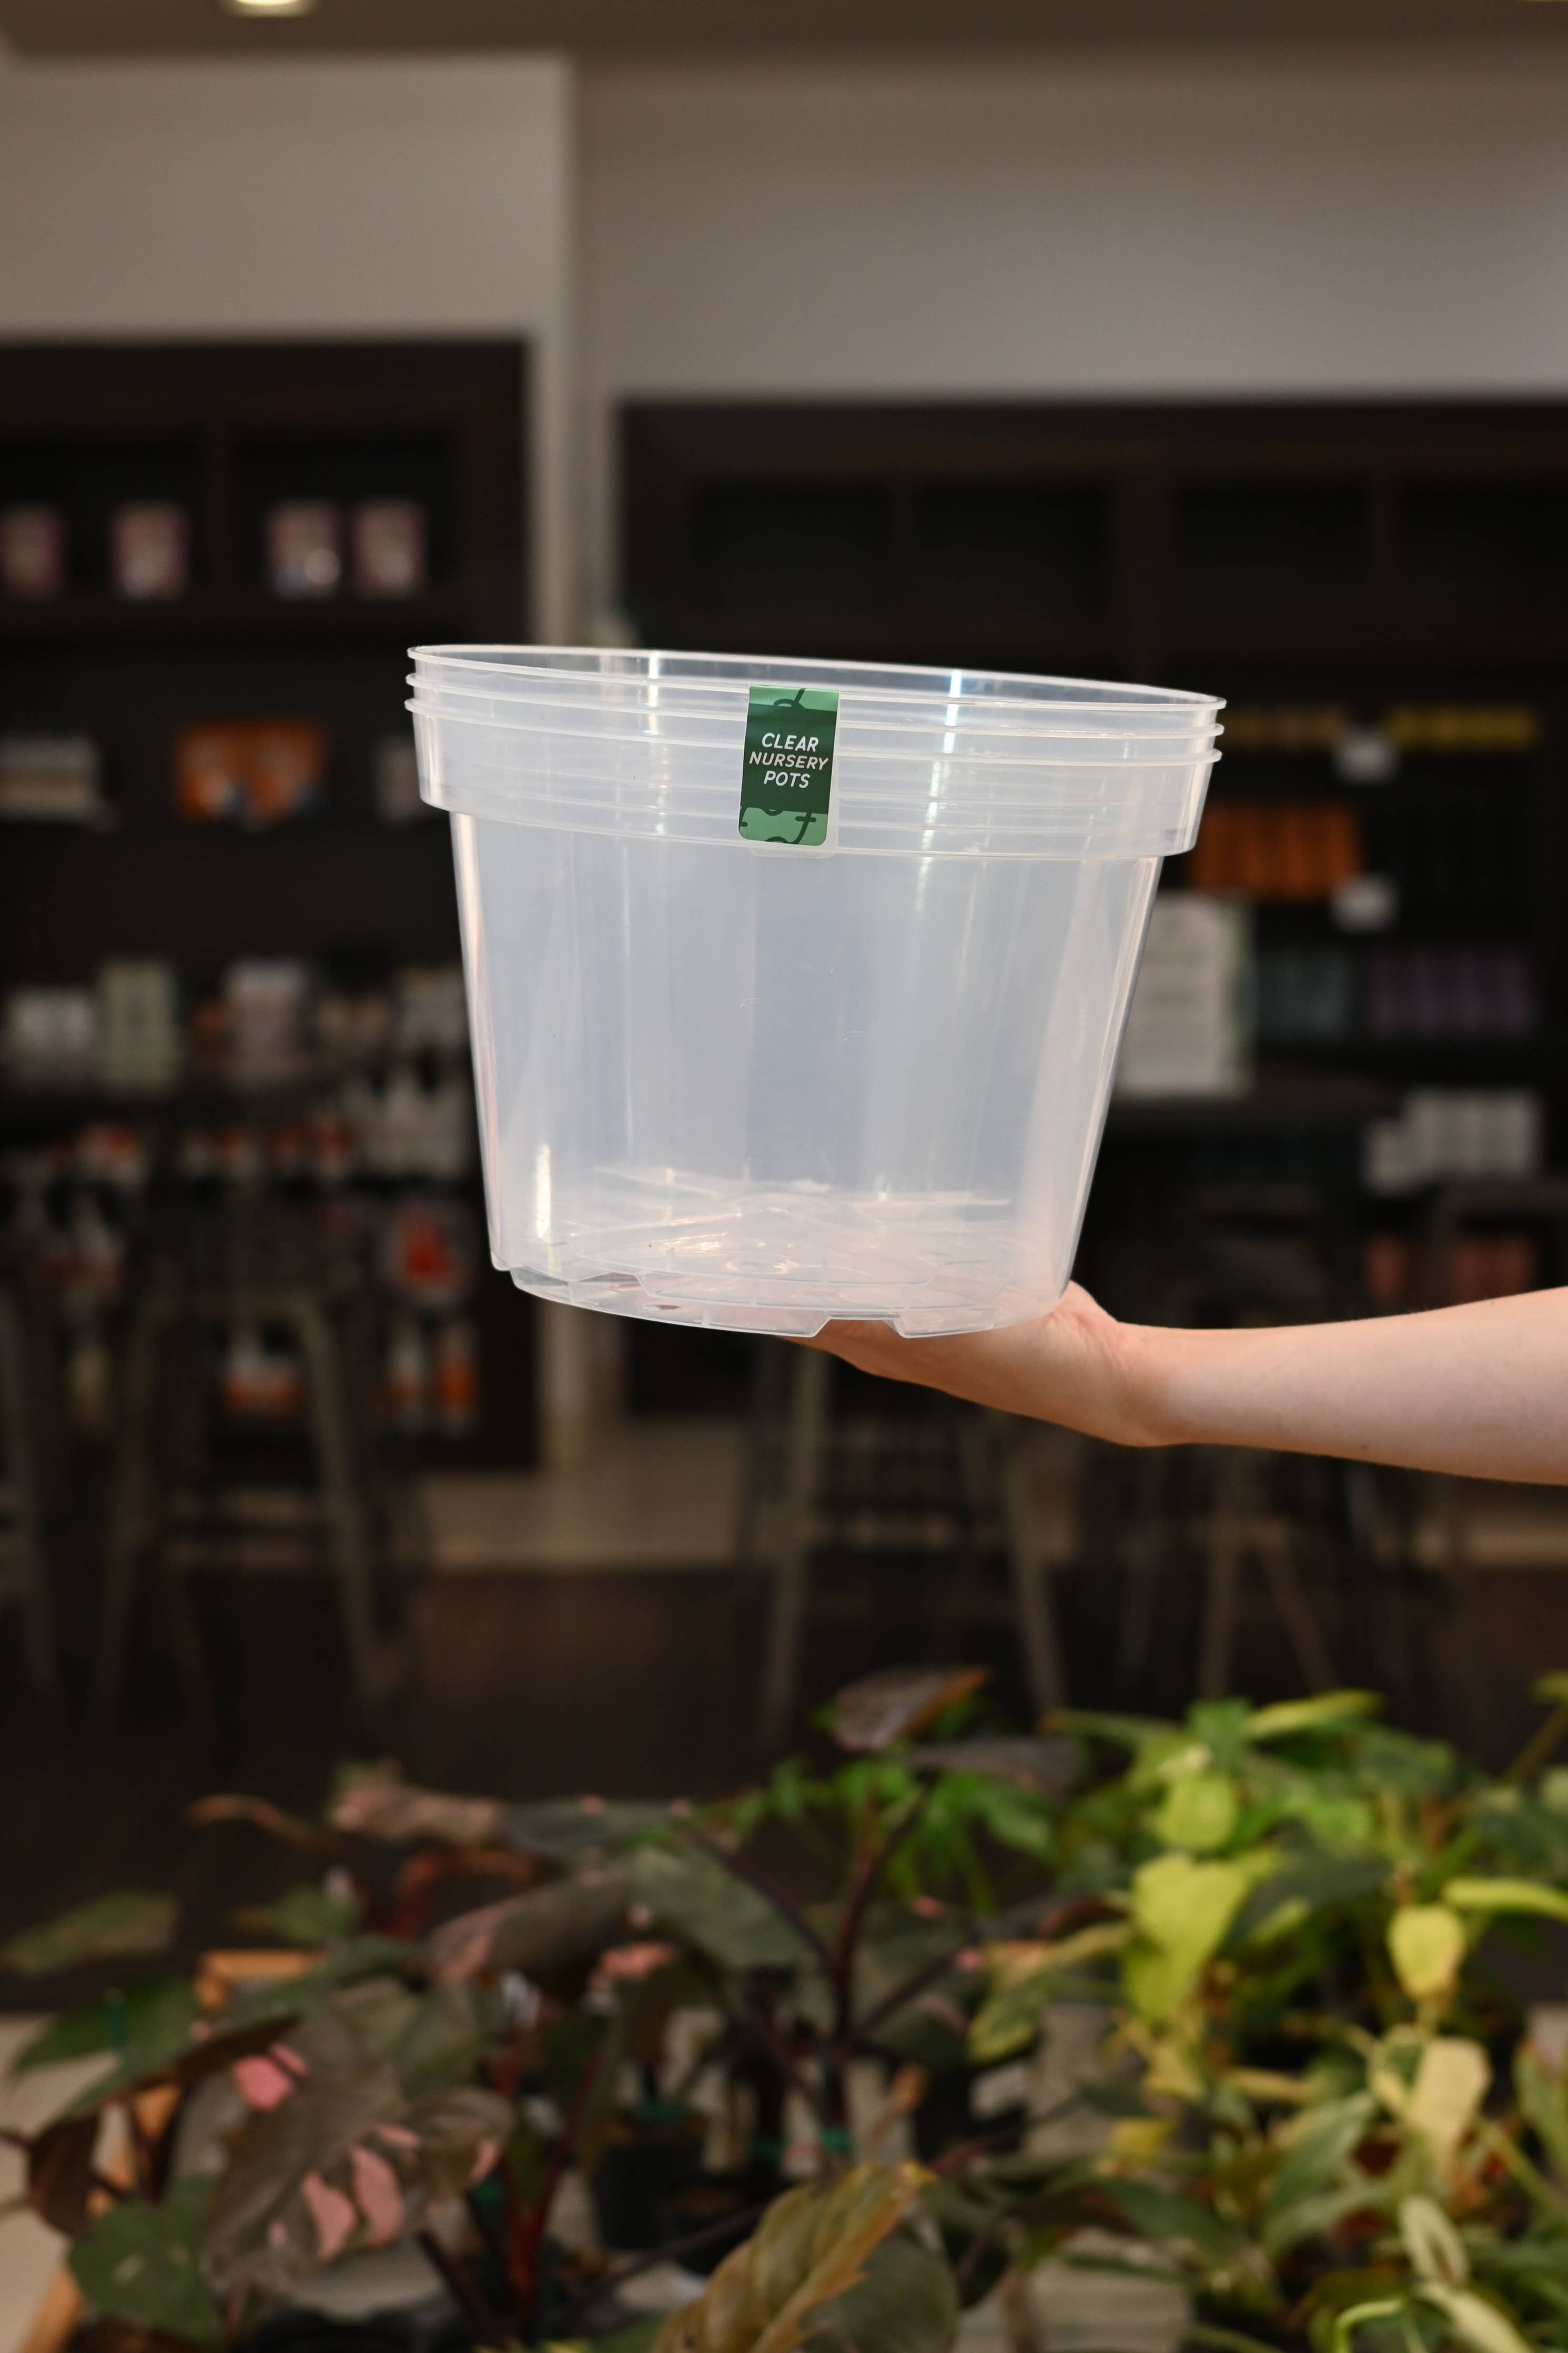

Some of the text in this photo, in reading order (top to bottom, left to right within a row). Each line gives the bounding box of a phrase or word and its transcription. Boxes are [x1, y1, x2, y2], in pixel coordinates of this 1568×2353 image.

[762, 732, 819, 752] CLEAR
[749, 751, 828, 770] NURSERY
[763, 770, 811, 788] POTS
